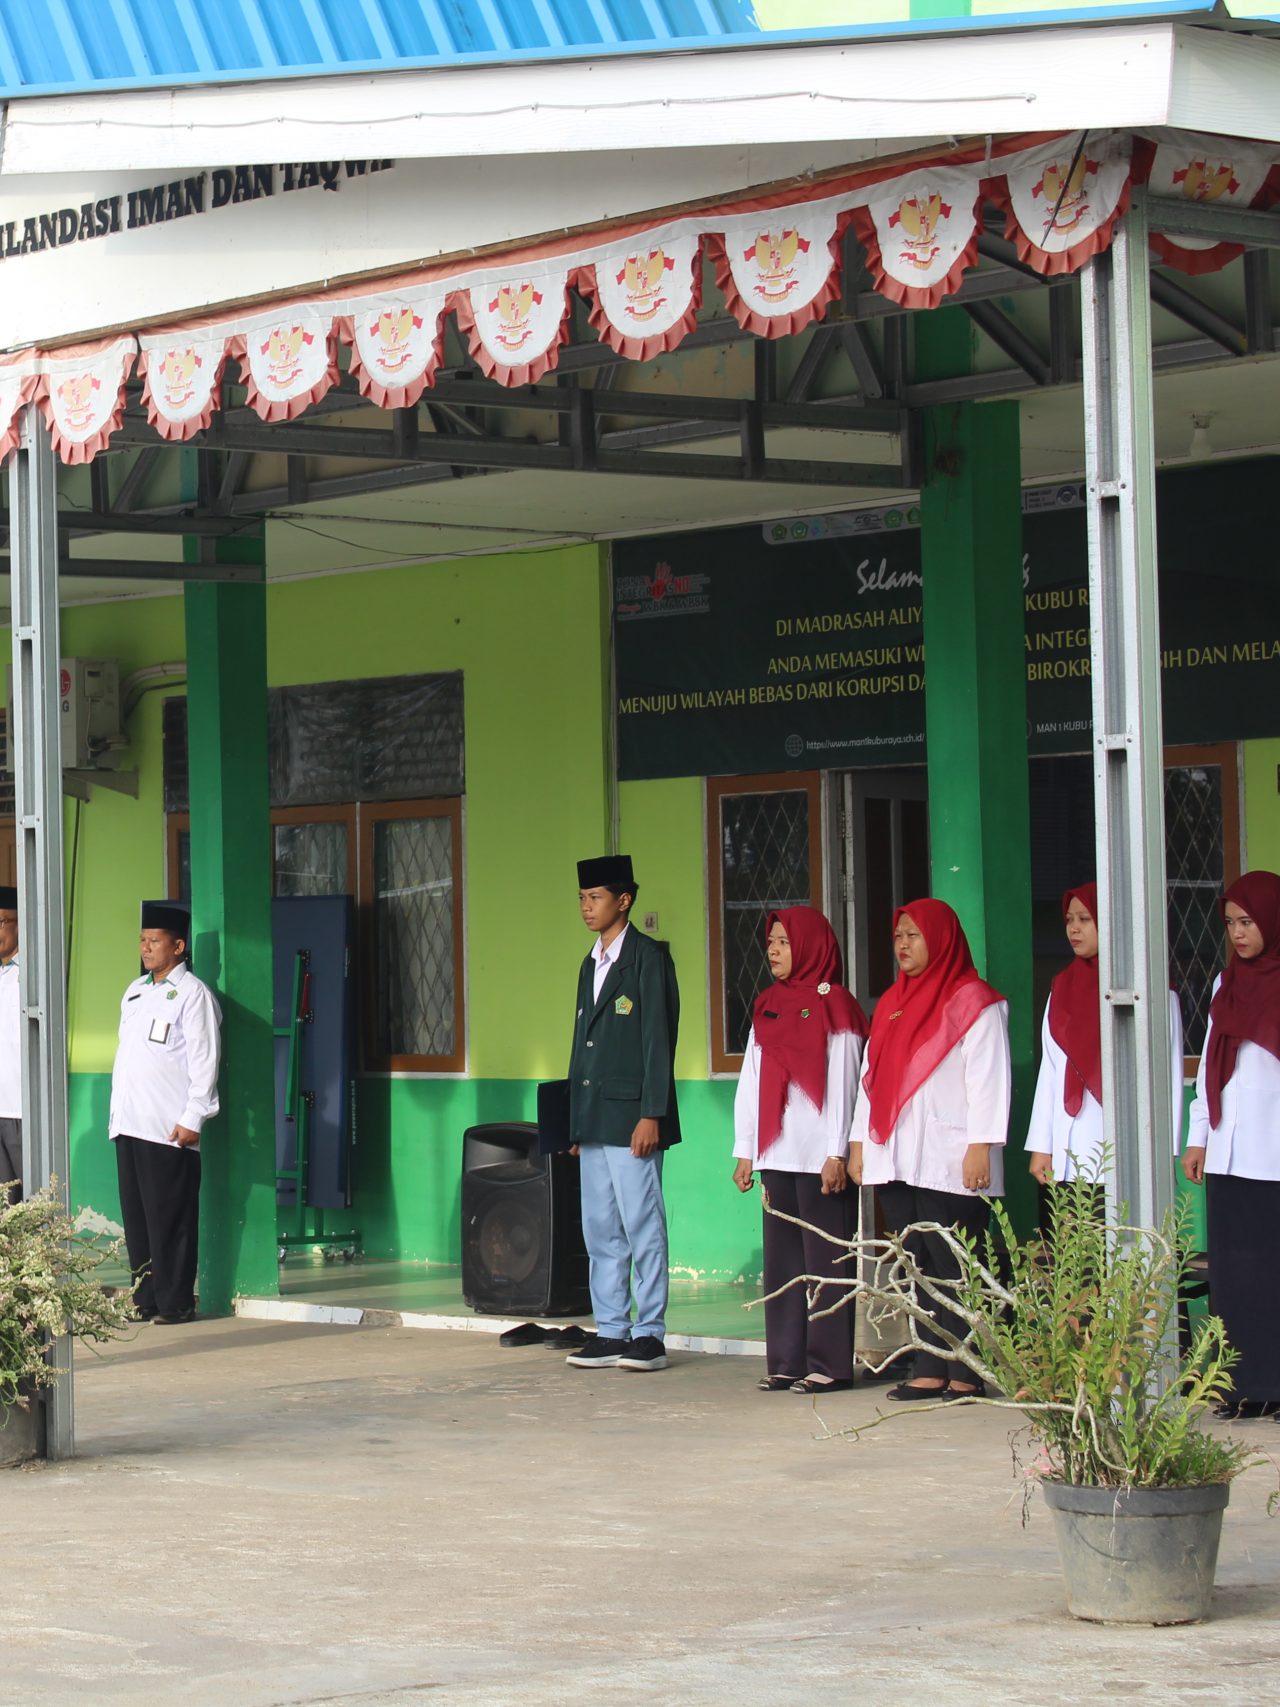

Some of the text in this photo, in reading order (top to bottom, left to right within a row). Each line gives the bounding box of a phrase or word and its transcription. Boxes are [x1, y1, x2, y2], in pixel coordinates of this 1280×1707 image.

[127, 175, 204, 229] IMAN
[211, 164, 273, 208] DAN
[857, 558, 924, 594] Selam
[776, 619, 792, 636] DI
[795, 610, 884, 635] MADRASAH
[1025, 590, 1073, 611] KUBU
[767, 655, 812, 675] ANDA
[815, 647, 901, 671] MEMASUKI
[1035, 629, 1092, 650] INTEG
[618, 694, 677, 715] MENUJU
[680, 688, 745, 709] WILAYAH
[749, 684, 793, 704] BEBAS
[796, 681, 832, 700] DARI
[836, 675, 904, 697] KORUPSI
[1027, 658, 1092, 681] BIROKR
[1186, 645, 1228, 666] DAN
[1035, 722, 1057, 734] MAN
[1063, 720, 1088, 732] KUBU
